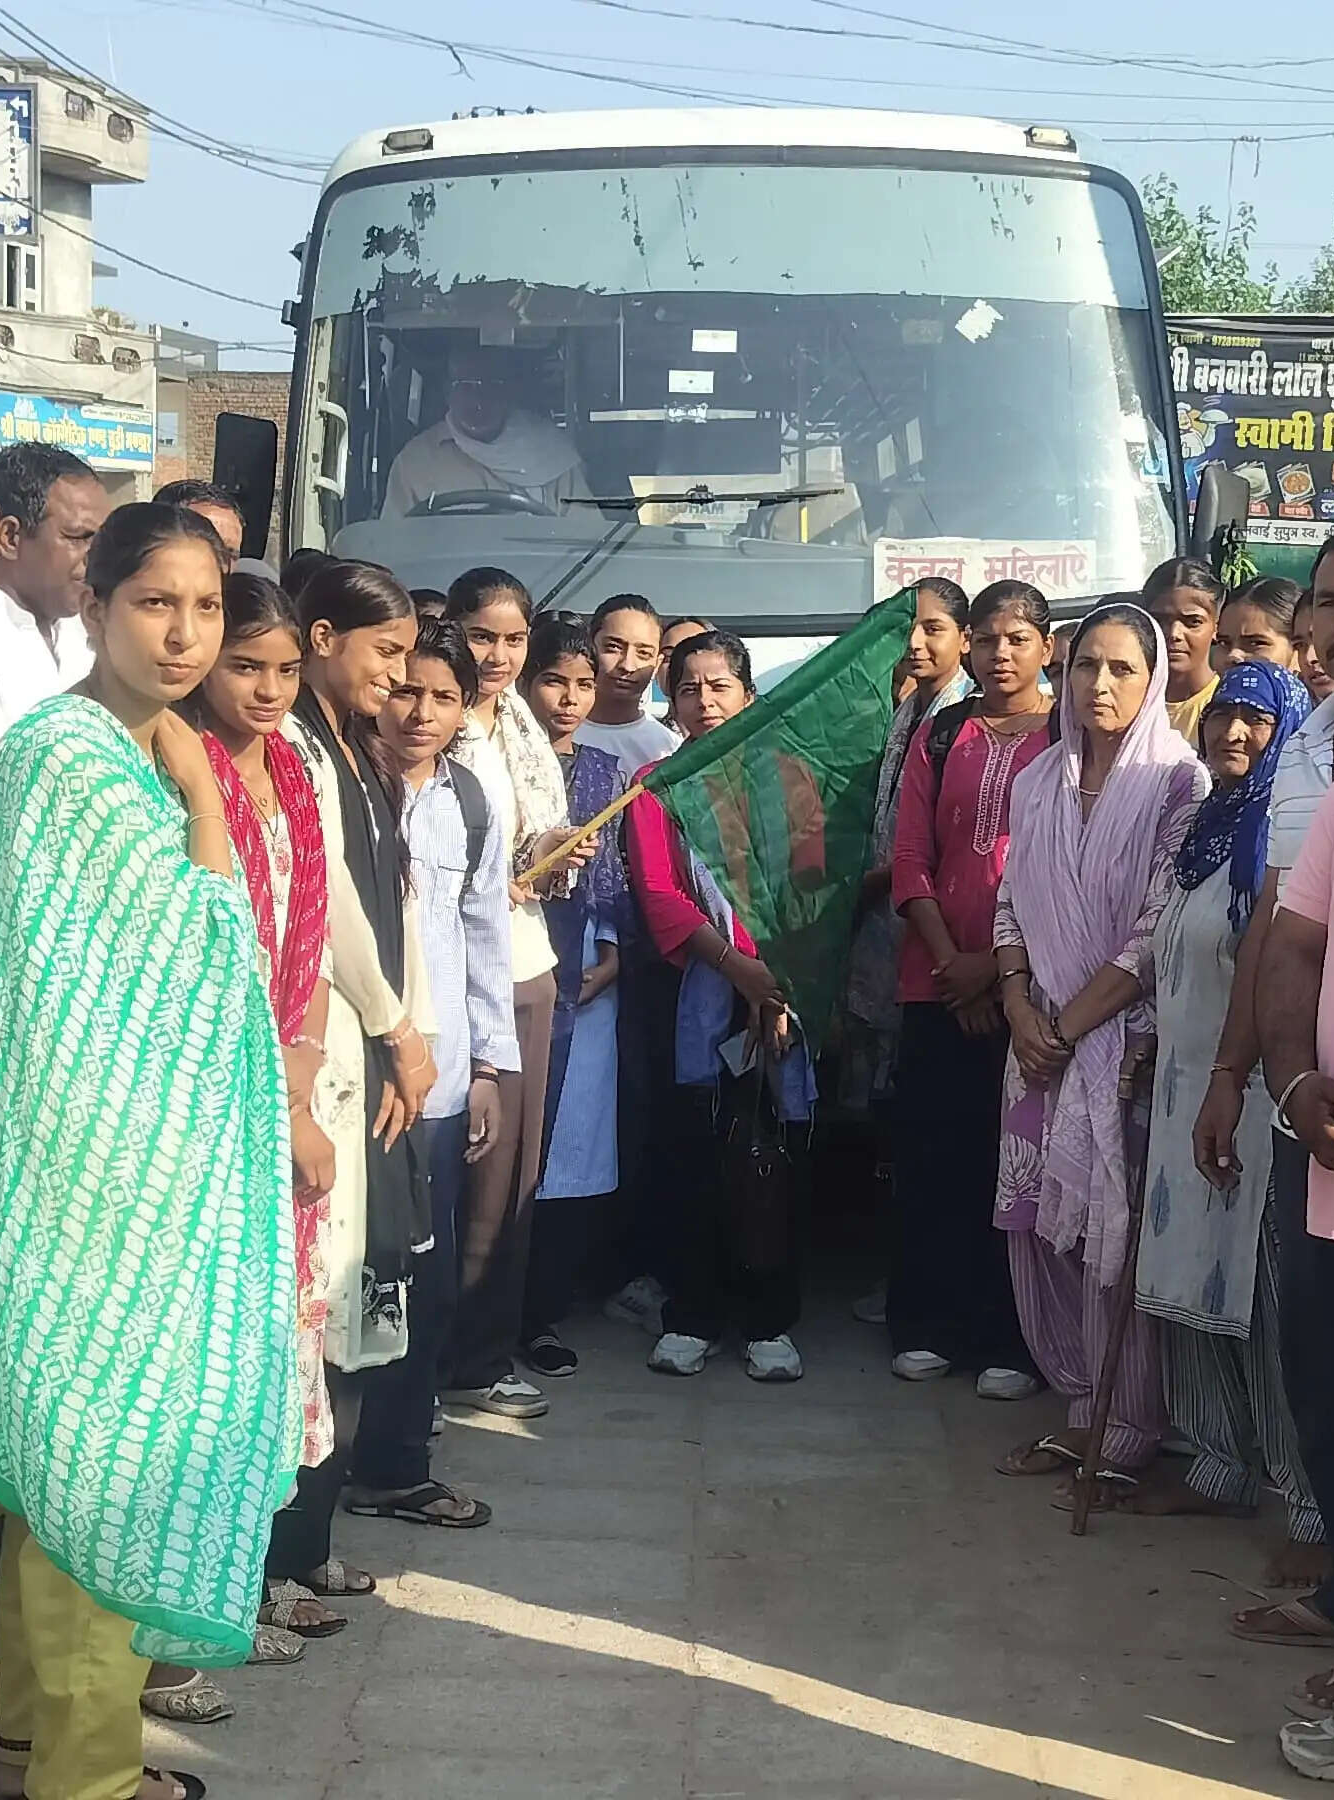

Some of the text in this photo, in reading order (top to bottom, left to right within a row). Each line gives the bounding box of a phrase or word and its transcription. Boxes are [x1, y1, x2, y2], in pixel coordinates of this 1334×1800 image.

[1193, 350, 1269, 396] बनवारी
[1271, 361, 1324, 398] लाल
[1234, 410, 1316, 452] स्वामी
